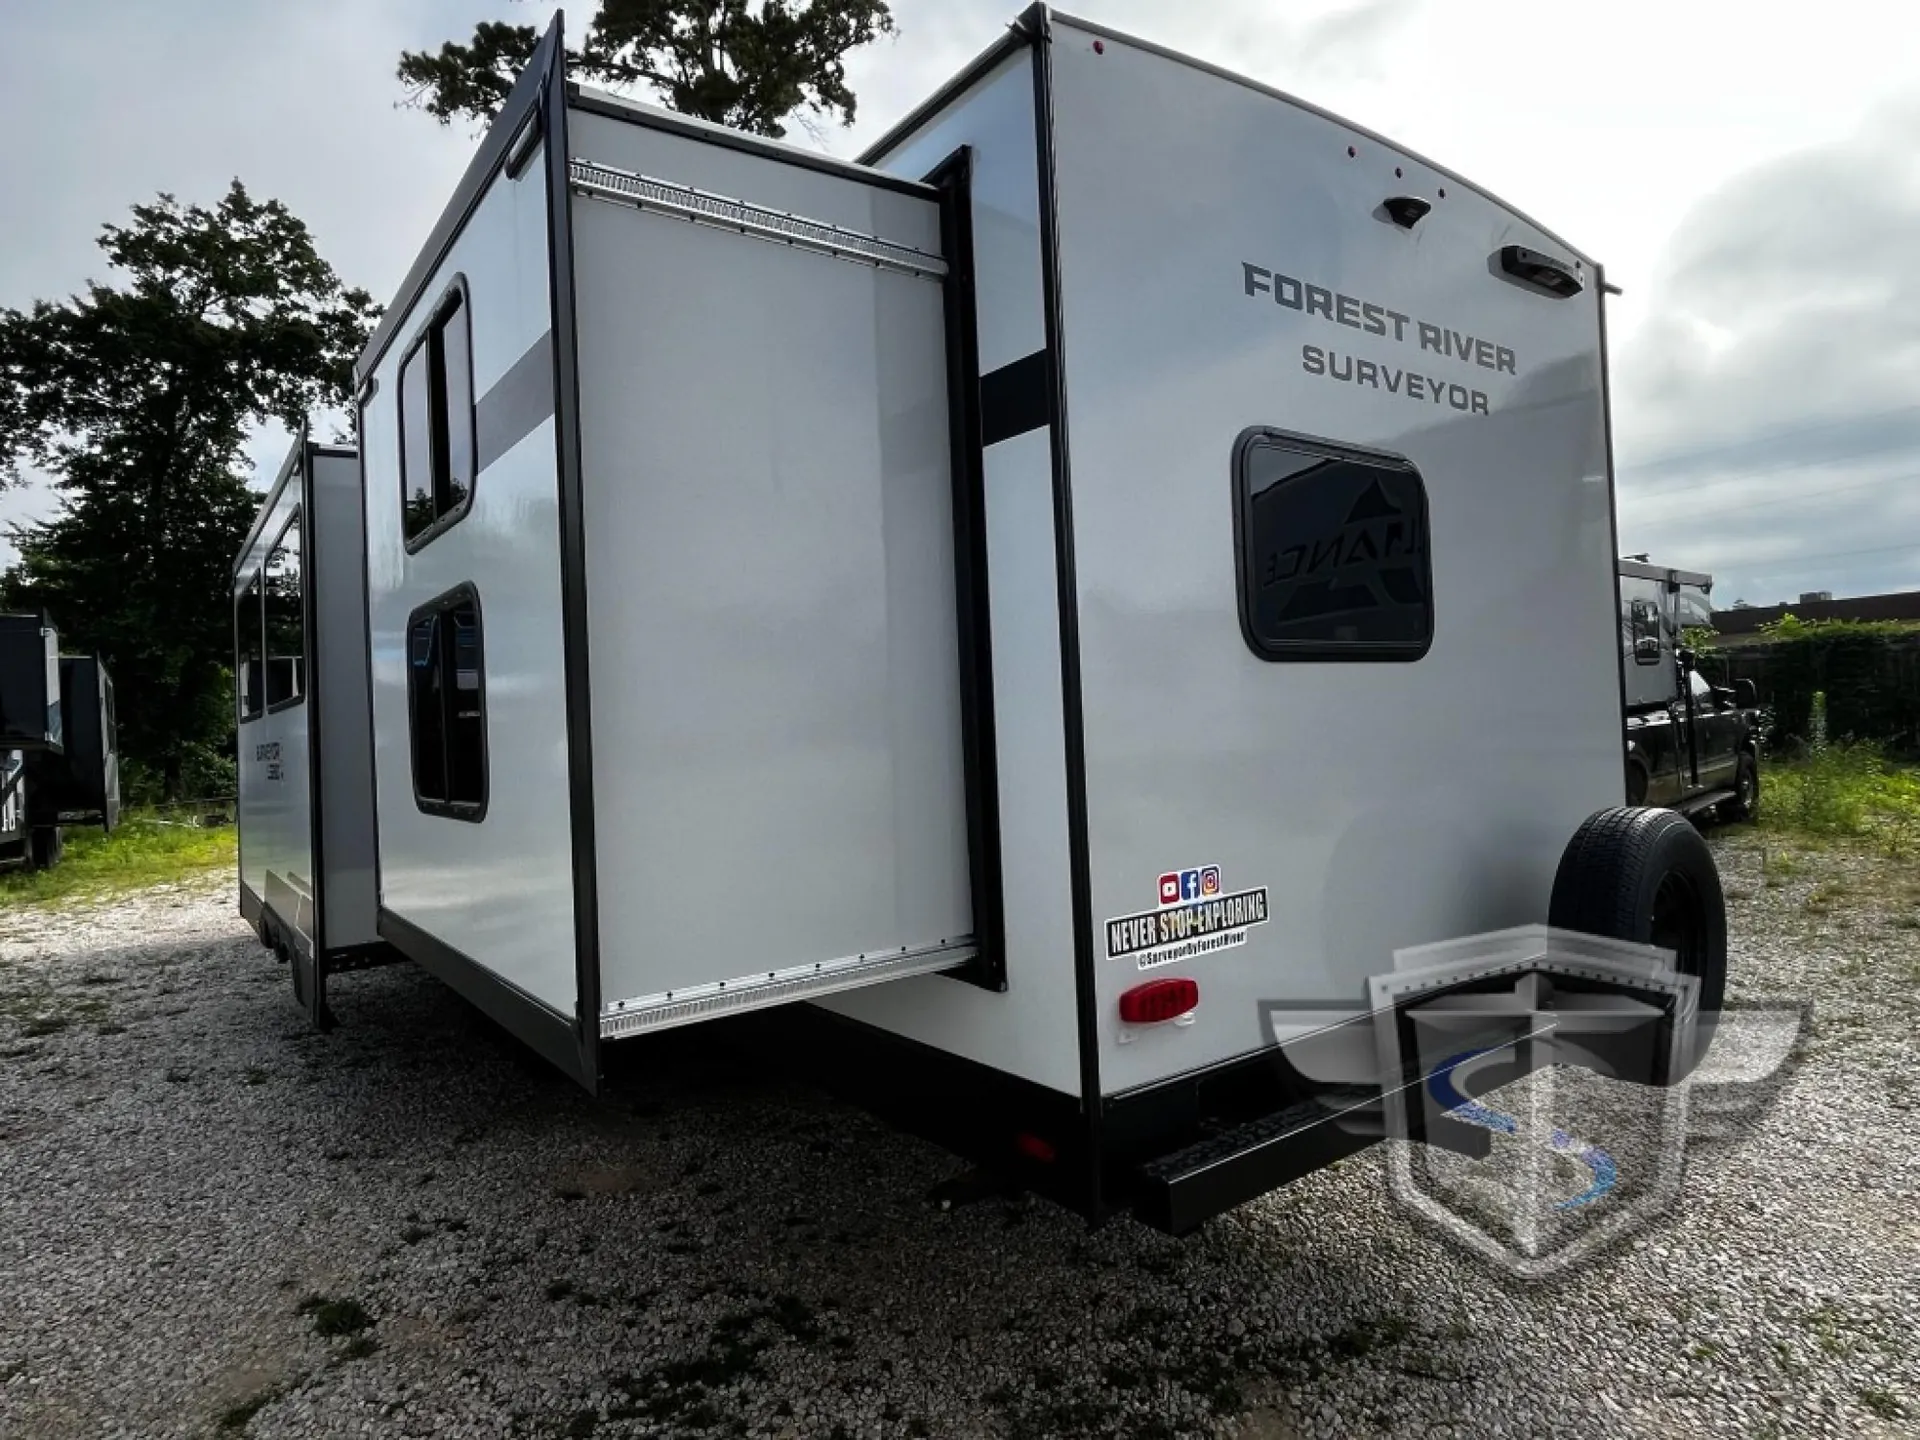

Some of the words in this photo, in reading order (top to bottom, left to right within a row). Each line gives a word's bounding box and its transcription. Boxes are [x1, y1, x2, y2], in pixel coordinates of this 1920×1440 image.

[1241, 261, 1410, 341] FOREST
[1417, 320, 1516, 375] RIVER
[1302, 344, 1489, 416] SURVEYOR
[1111, 916, 1157, 953] NEVER
[1160, 908, 1193, 941] STOP
[1197, 892, 1265, 932] EXPLORING
